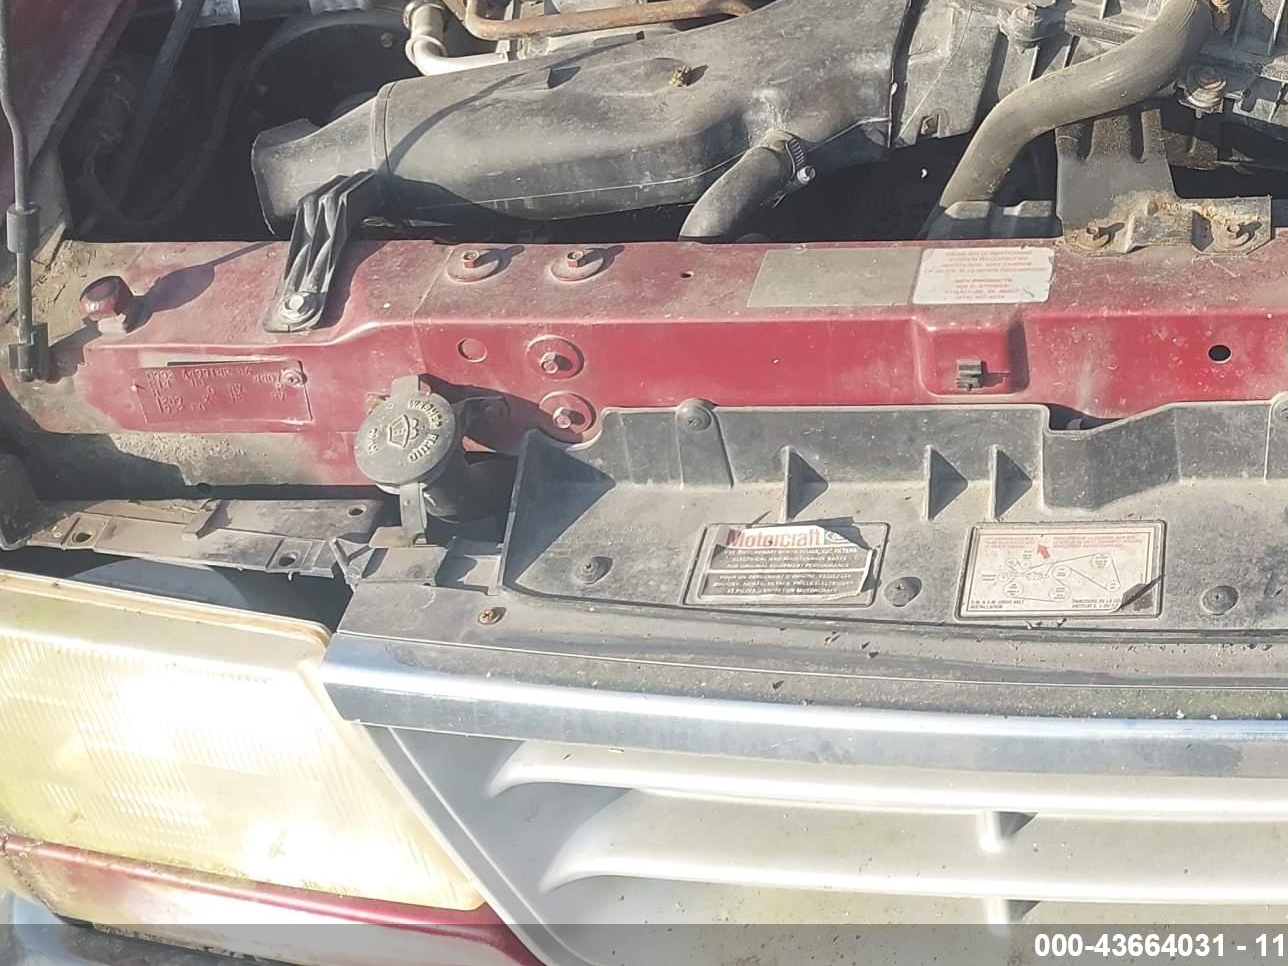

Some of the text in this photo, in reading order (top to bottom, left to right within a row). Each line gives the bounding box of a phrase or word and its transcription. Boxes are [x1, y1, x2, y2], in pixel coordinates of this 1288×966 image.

[408, 398, 443, 430] WASHER
[408, 432, 440, 464] FLUID
[726, 529, 821, 547] Motorcraft
